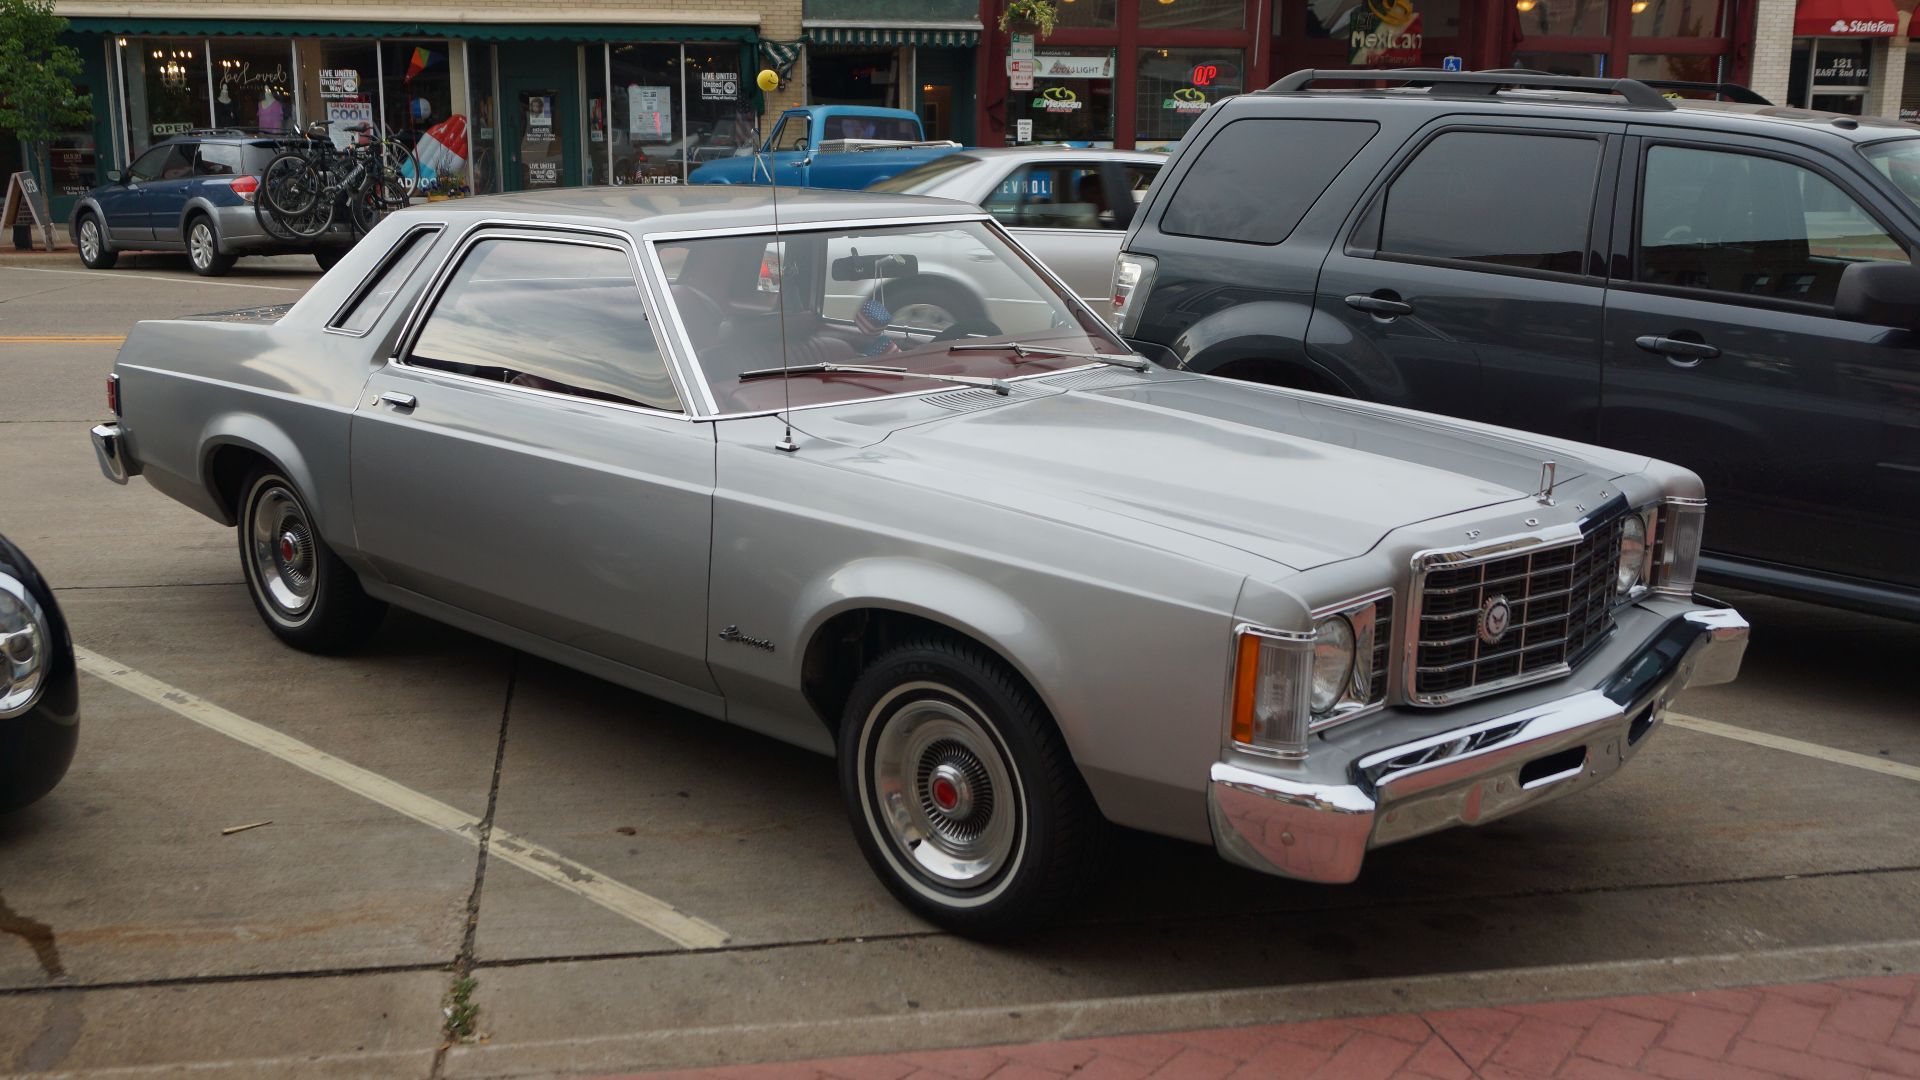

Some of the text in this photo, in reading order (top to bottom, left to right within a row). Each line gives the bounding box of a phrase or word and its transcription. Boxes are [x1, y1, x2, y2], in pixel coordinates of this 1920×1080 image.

[1351, 30, 1423, 49] Mexican
[1832, 59, 1852, 68] 121
[320, 69, 357, 77] LIVE UNITED
[1815, 69, 1836, 77] EAST
[1839, 69, 1853, 77] 2nd
[1043, 99, 1082, 109] Mexican
[331, 109, 370, 120] COOL!
[154, 124, 193, 134] OPEN
